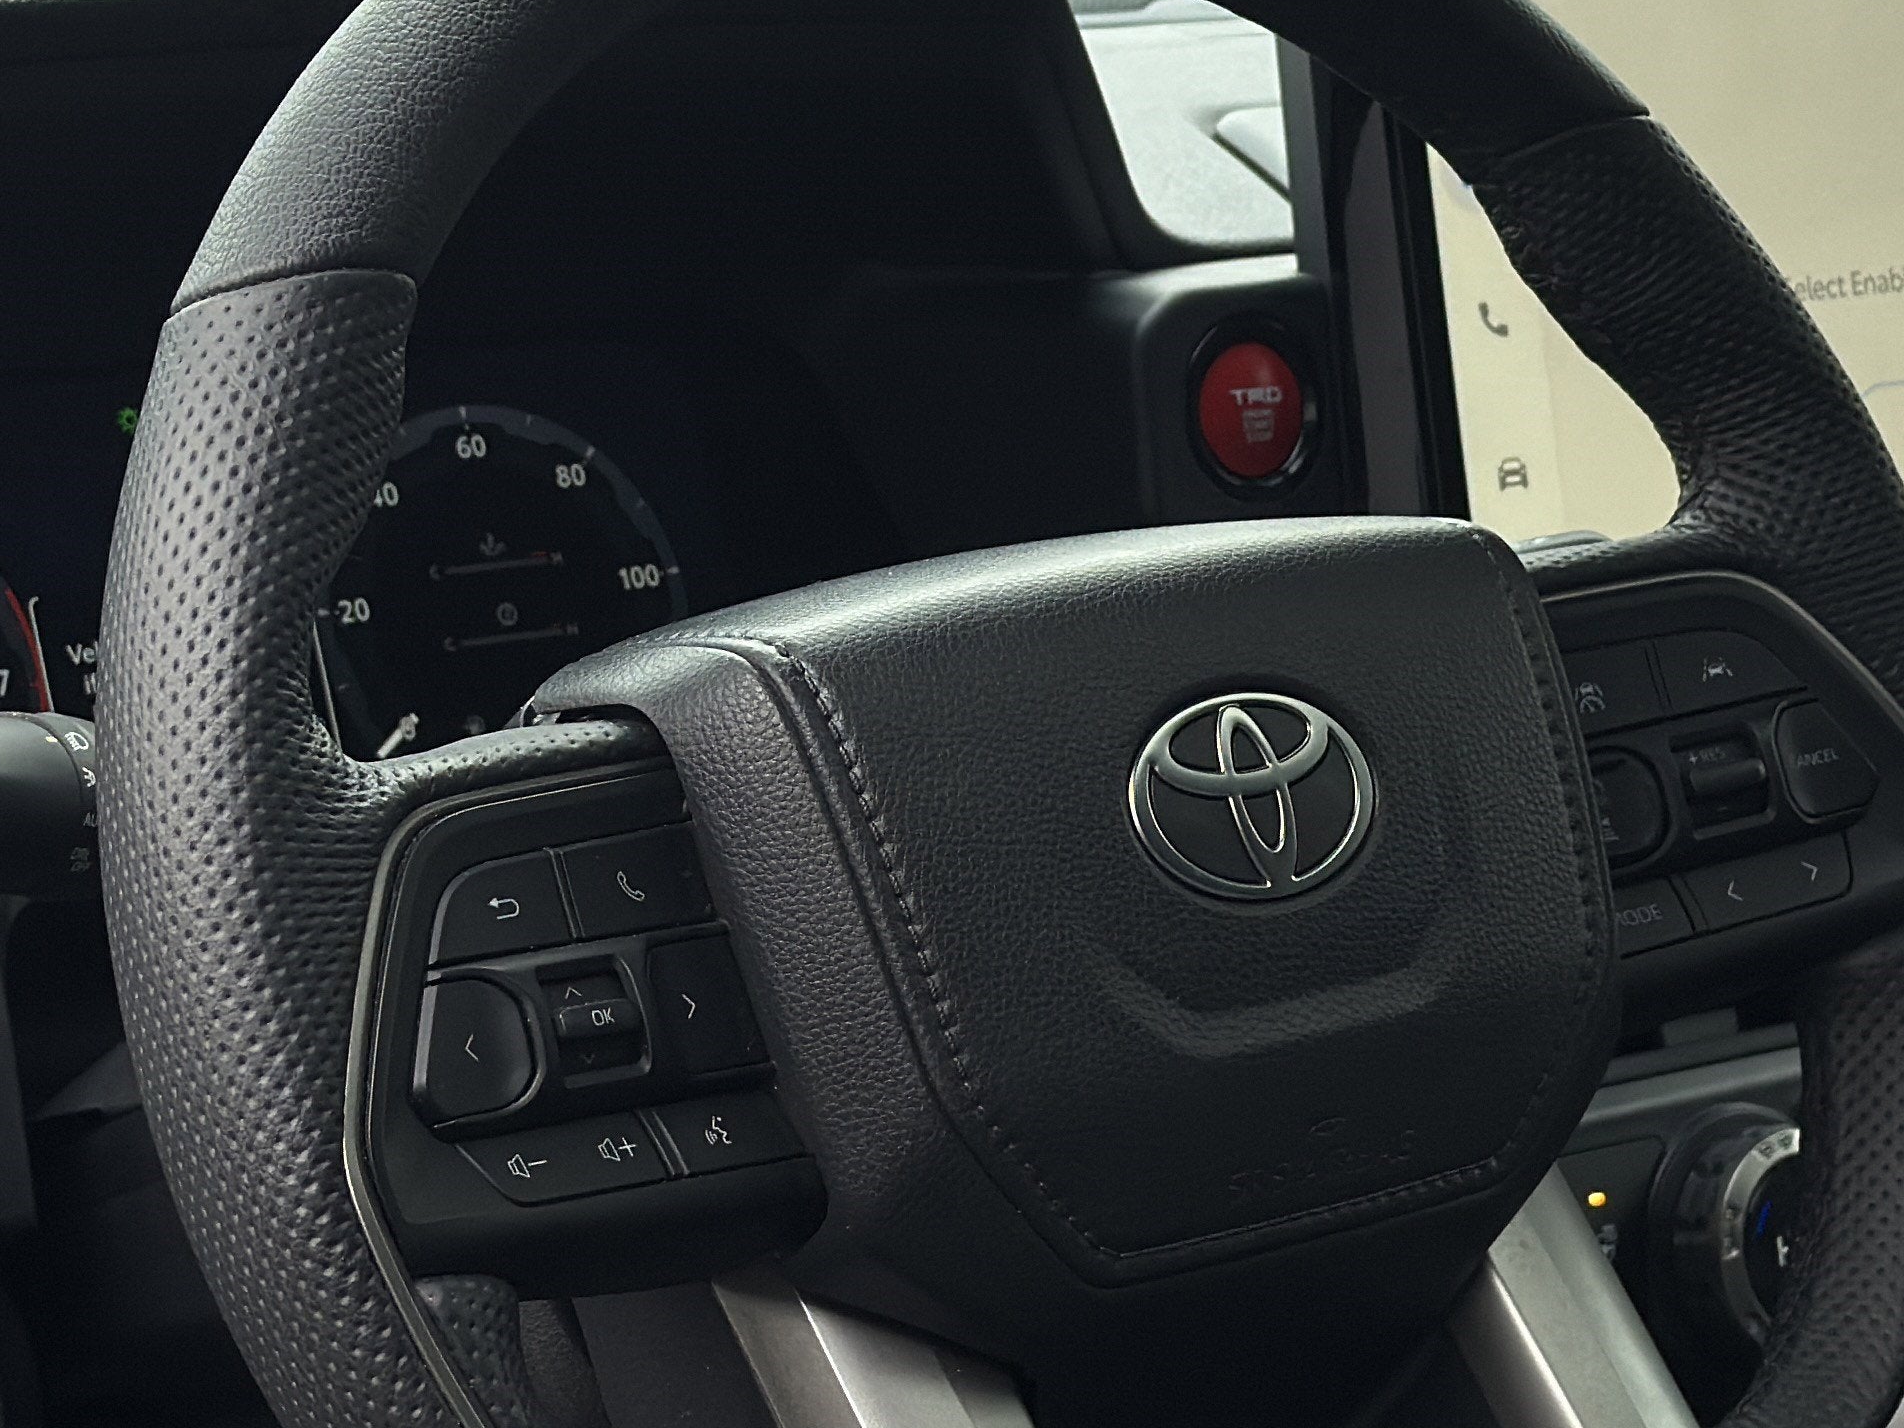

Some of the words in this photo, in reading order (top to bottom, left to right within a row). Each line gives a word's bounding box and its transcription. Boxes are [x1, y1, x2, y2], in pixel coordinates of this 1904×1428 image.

[1792, 274, 1848, 301] elect
[1229, 385, 1283, 405] TRD
[455, 434, 486, 459] 60
[555, 463, 587, 489] 80
[618, 564, 662, 591] 100
[338, 597, 370, 624] 20
[1797, 746, 1841, 767] ANCEL
[591, 1007, 616, 1026] OK
